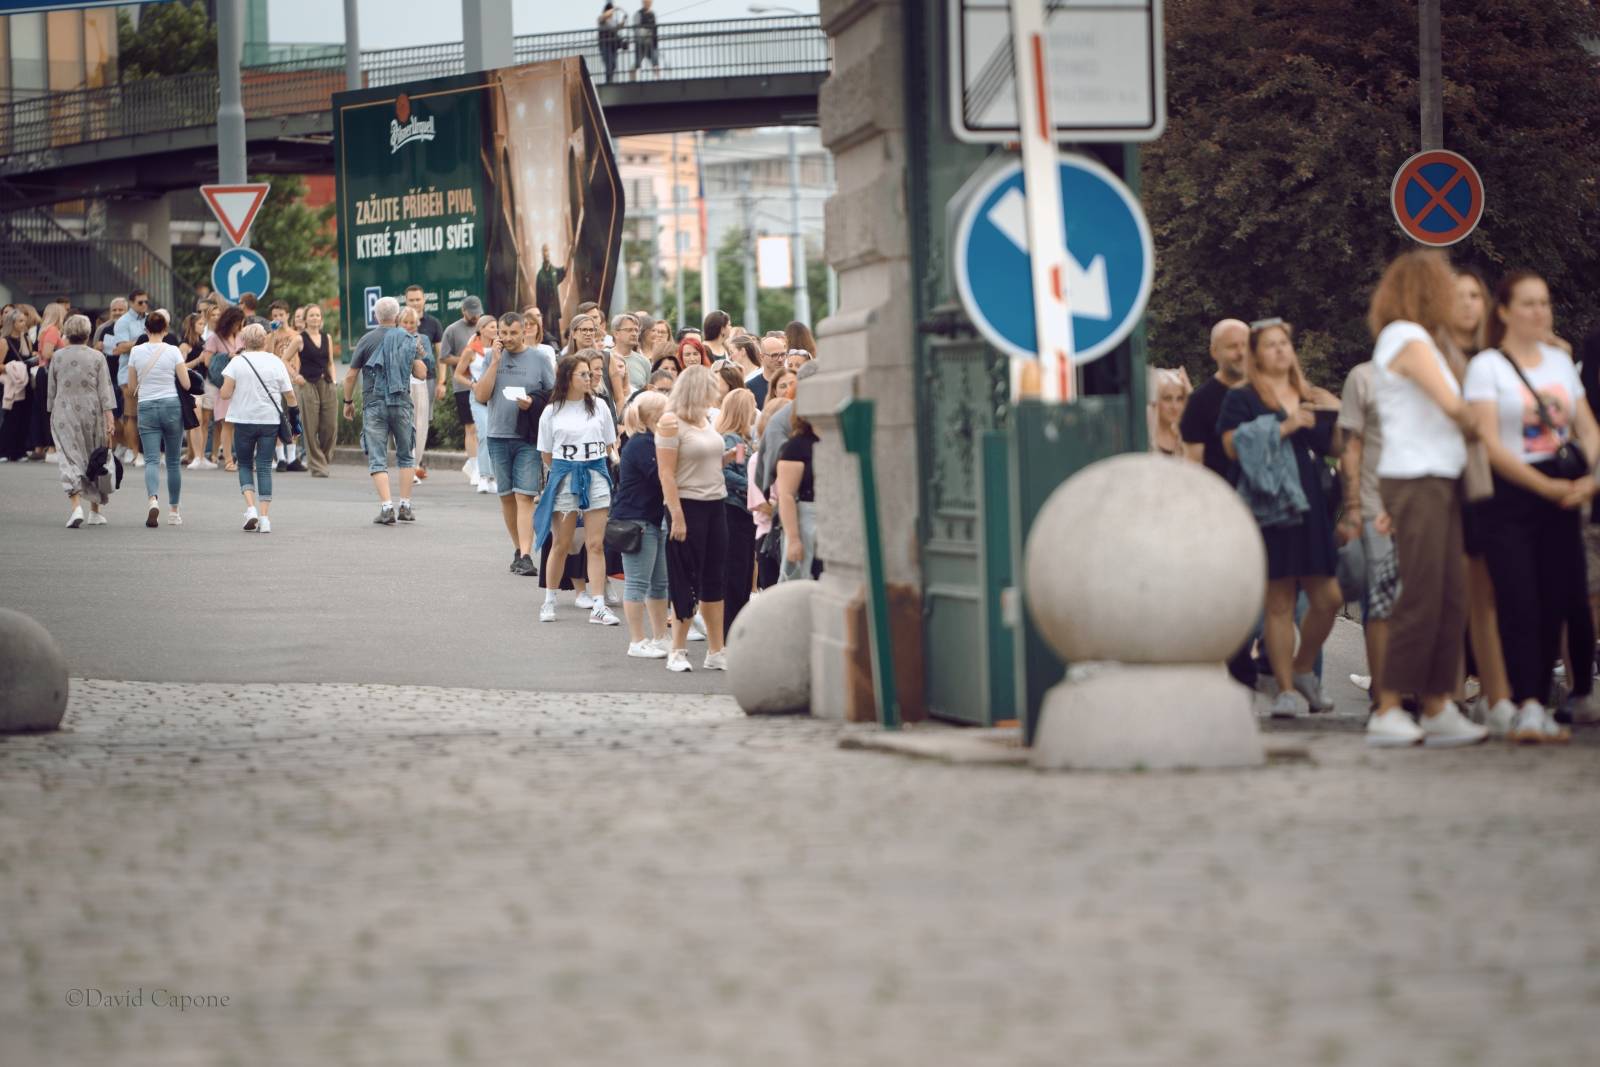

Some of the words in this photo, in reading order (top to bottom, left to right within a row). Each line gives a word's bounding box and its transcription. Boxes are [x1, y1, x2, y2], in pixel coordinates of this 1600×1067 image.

[355, 193, 400, 226] ZAŽIJTE
[402, 186, 444, 220] PŘÍBĚH
[447, 187, 477, 216] PIVA,
[356, 226, 391, 260] KTERÉ
[393, 222, 444, 255] ZMĚNILO
[446, 217, 475, 249] SVĚT
